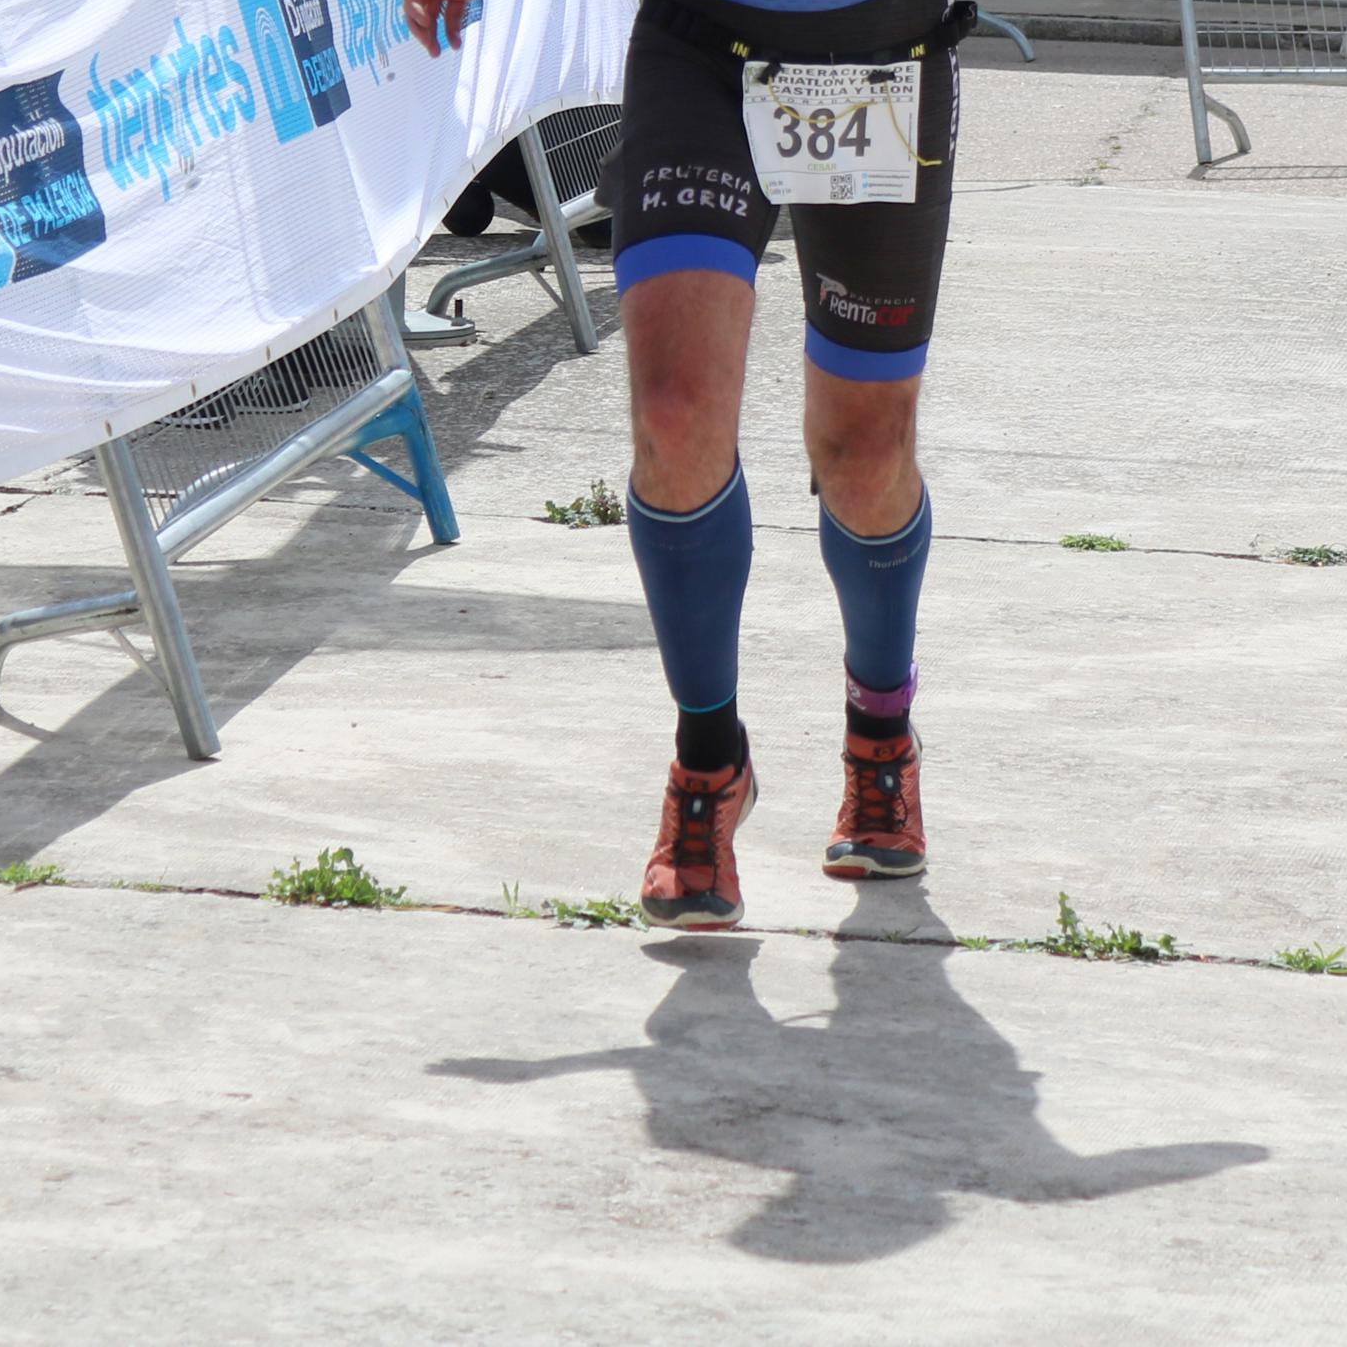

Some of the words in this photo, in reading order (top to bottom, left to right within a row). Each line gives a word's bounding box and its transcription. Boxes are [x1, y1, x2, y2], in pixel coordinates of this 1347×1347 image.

[893, 65, 915, 74] DE
[893, 75, 915, 84] DE
[772, 85, 852, 97] CASTILLA
[855, 87, 865, 95] Y
[773, 105, 871, 160] 384
[643, 165, 752, 195] FRUTERIA
[677, 188, 748, 217] CRUZ
